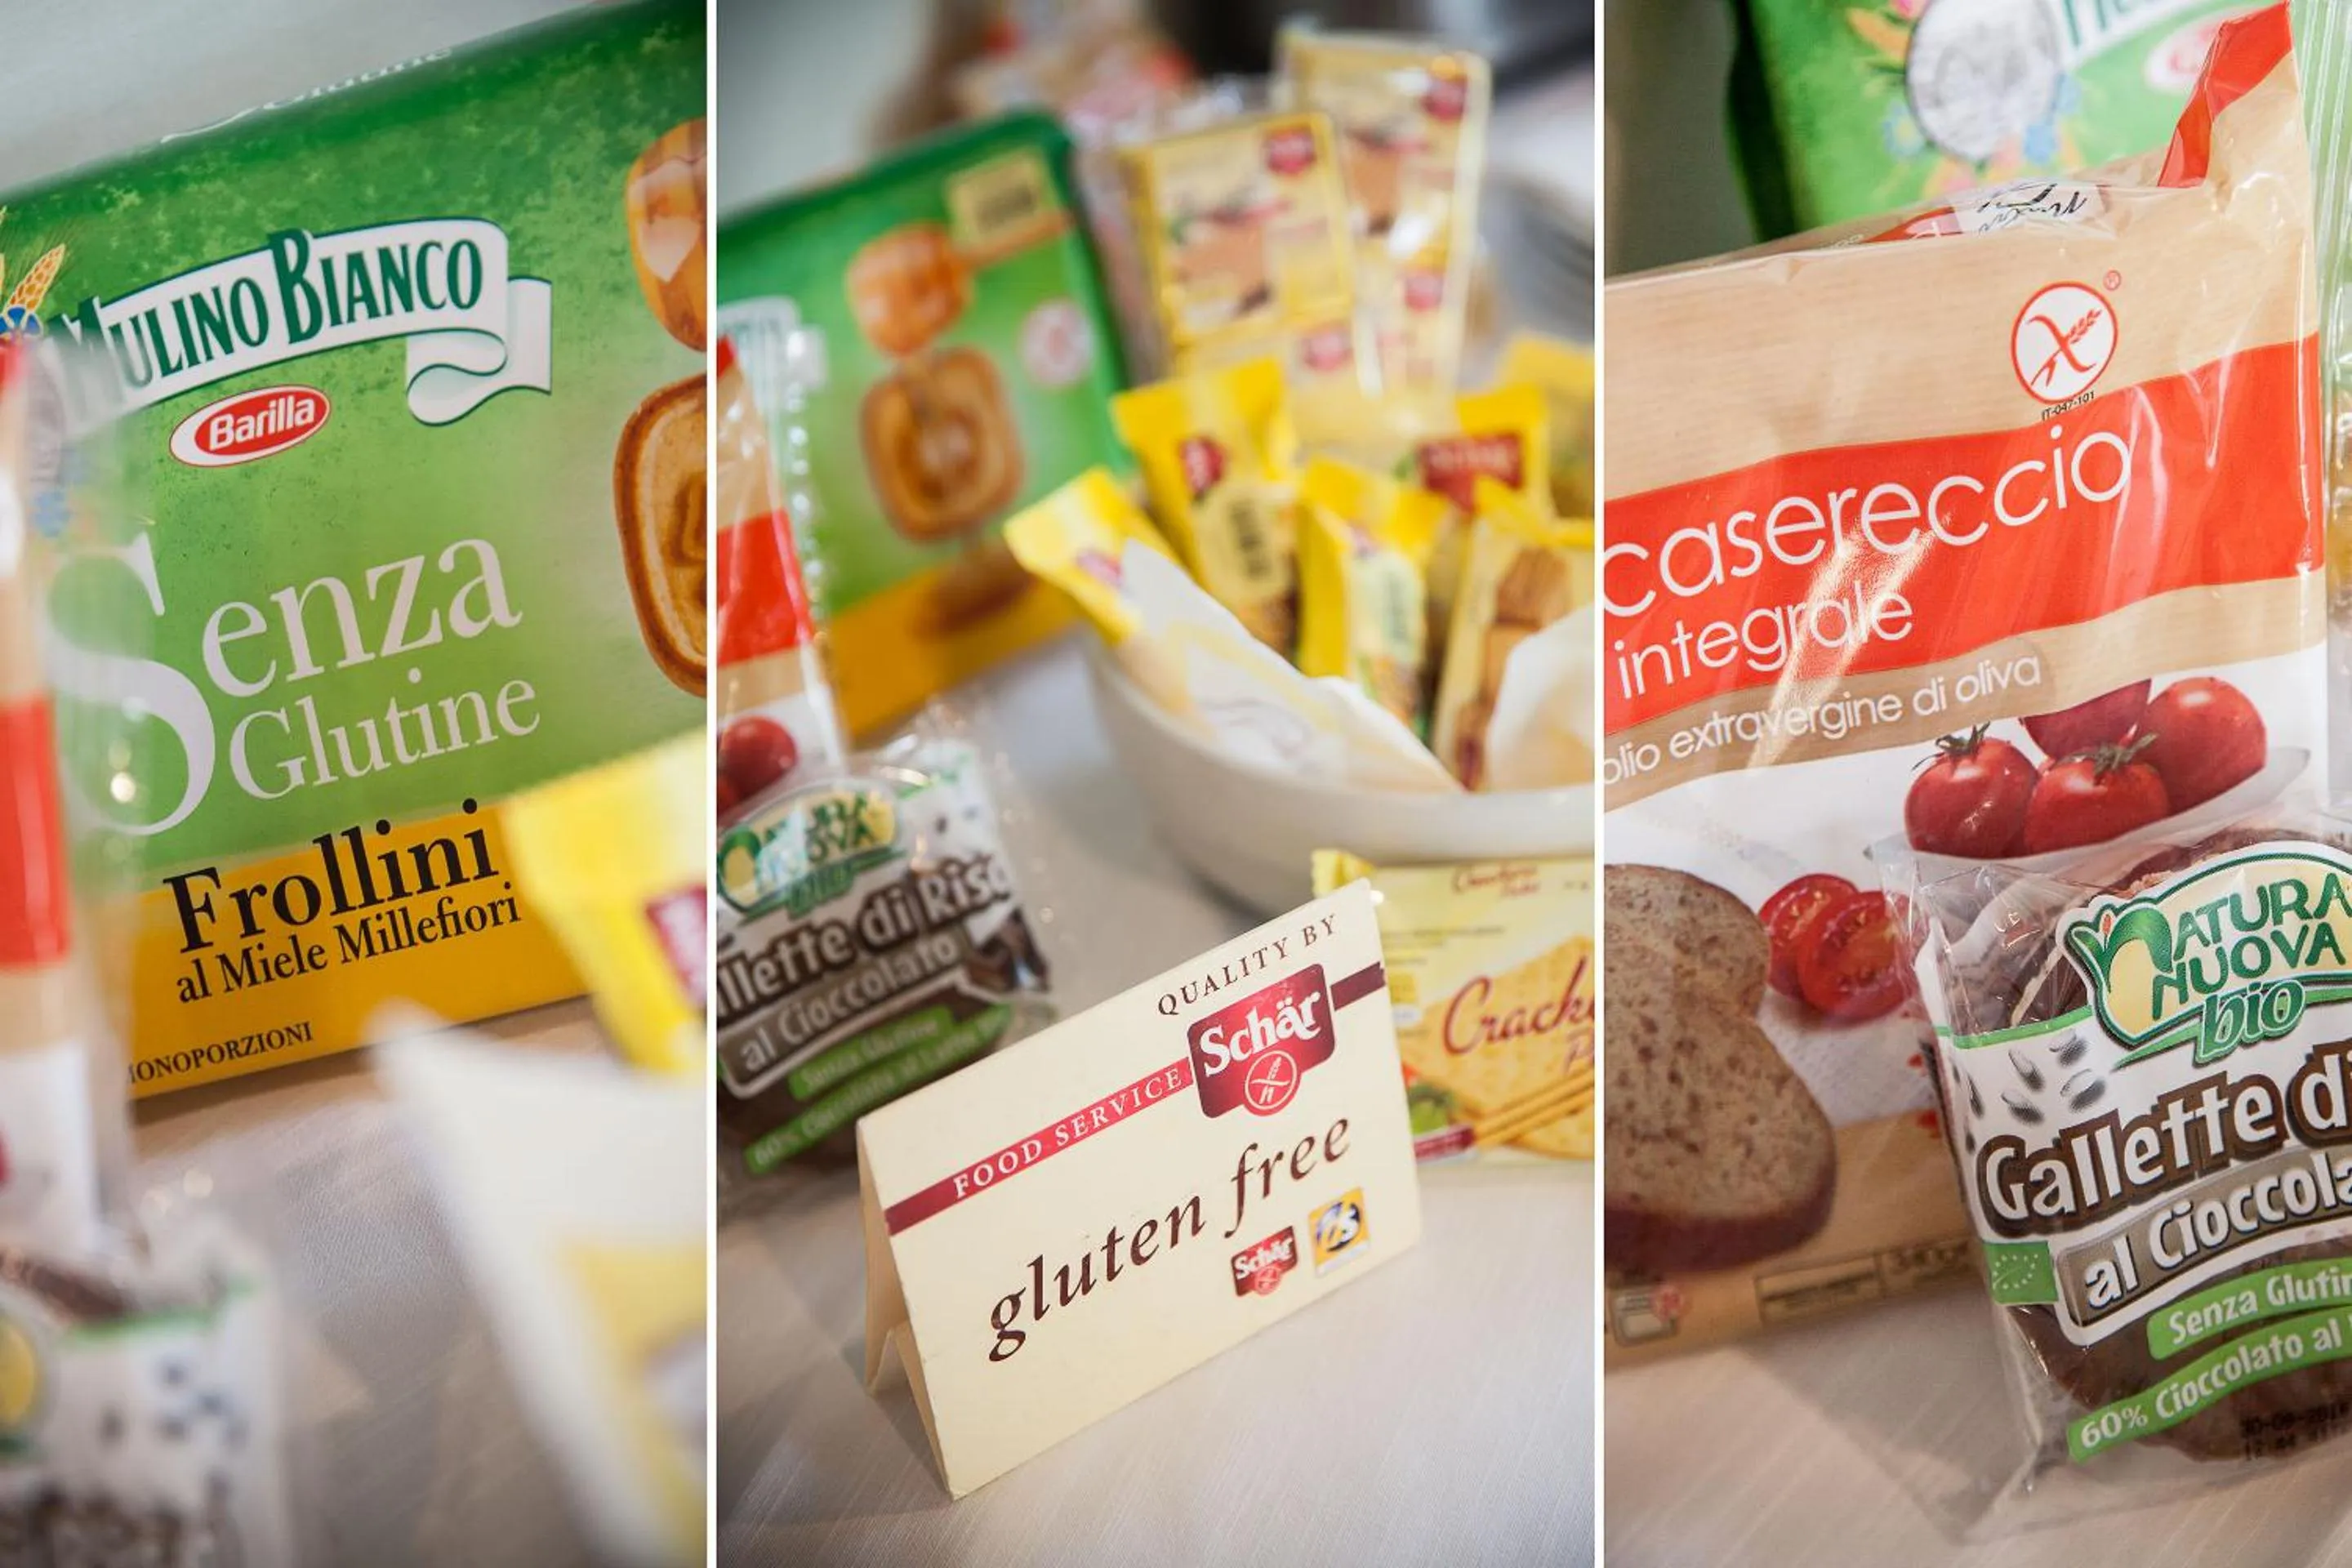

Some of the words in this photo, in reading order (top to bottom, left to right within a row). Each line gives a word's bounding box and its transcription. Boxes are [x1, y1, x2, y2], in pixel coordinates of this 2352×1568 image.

[267, 228, 483, 345] BIANCO
[208, 395, 315, 452] Barilla
[1603, 425, 2132, 617] casereccio
[41, 531, 523, 835] Senza
[1615, 577, 1913, 702] integrale
[229, 667, 541, 800] Glutine
[1604, 742, 1660, 785] olio
[1668, 691, 1904, 762] extravergine
[1913, 679, 1948, 717] di
[1954, 656, 2042, 704] oliva
[163, 798, 500, 953] Frollini
[176, 959, 212, 1003] al
[216, 935, 327, 994] Miele
[334, 881, 521, 964] Millefiori
[717, 921, 854, 1018] llette
[862, 887, 915, 947] di
[741, 1026, 776, 1072] al
[777, 938, 958, 1045] Cioccolato
[1157, 937, 1291, 1018] QUALITY
[1301, 914, 1339, 949] BY
[2152, 921, 2346, 1021] NUOVA
[1200, 990, 1321, 1078] Schär
[2195, 979, 2306, 1065] bio
[952, 1138, 1044, 1200] FOOD
[1056, 1067, 1184, 1148] SERVICE
[1985, 1082, 2278, 1221] Gallette
[988, 1194, 1206, 1363] gluten
[1223, 1117, 1352, 1240] free
[2084, 1235, 2139, 1310] al
[2168, 1289, 2259, 1346] Senza
[2080, 1403, 2149, 1450] 60%
[2155, 1333, 2304, 1420] Cioccolato
[2312, 1317, 2343, 1352] al
